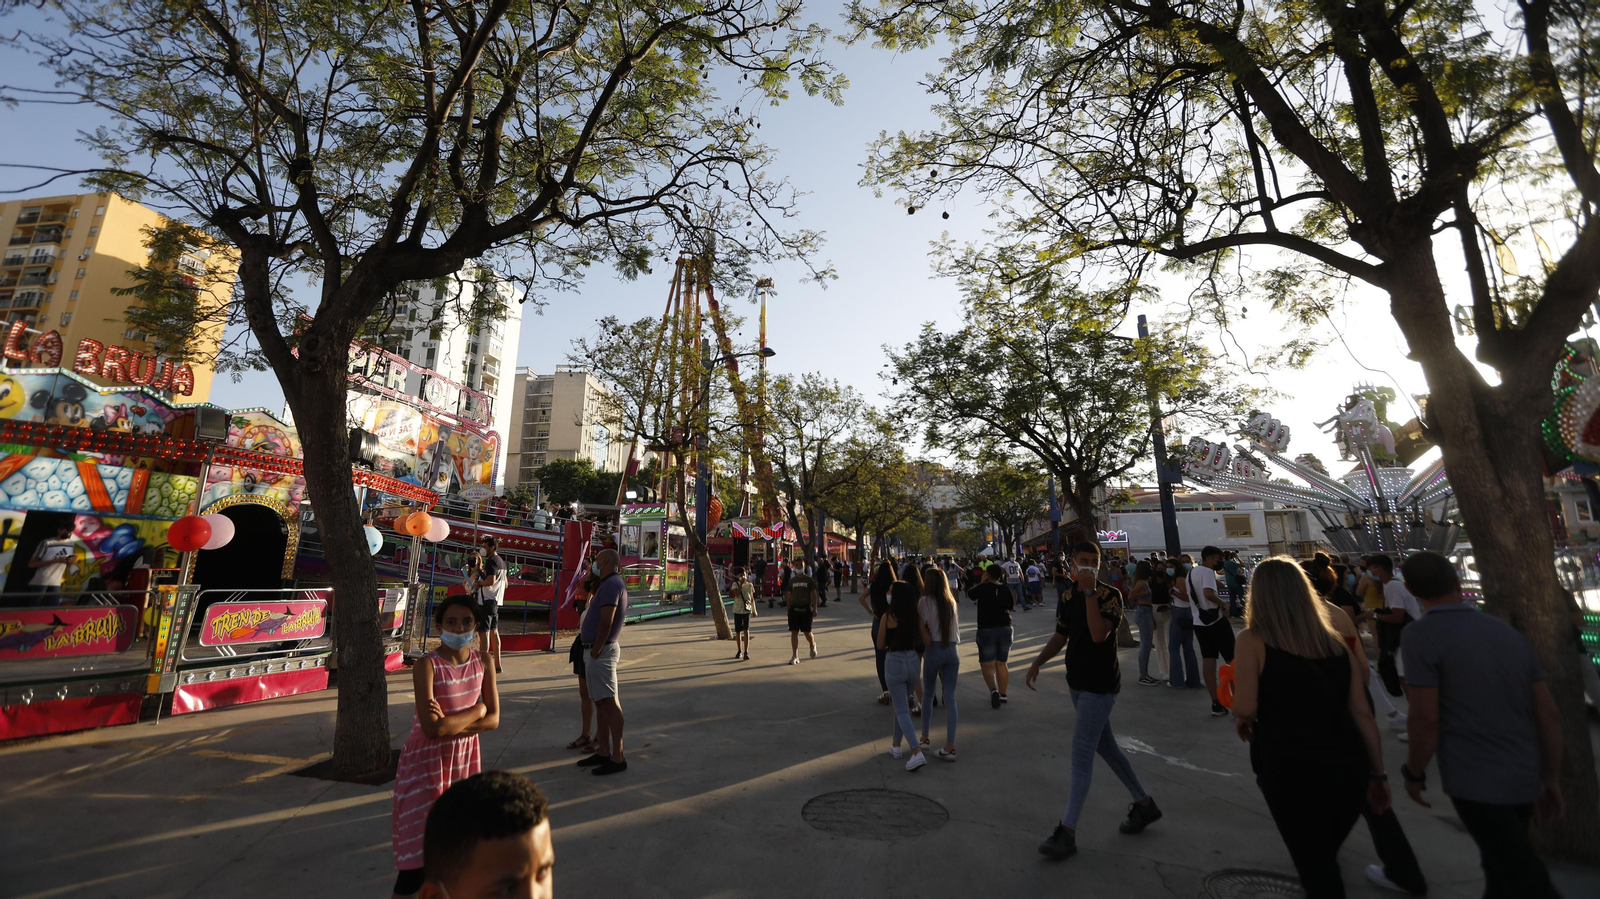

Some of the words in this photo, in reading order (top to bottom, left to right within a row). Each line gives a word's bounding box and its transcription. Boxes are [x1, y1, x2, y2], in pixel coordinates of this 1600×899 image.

[4, 320, 63, 367] LA
[73, 337, 194, 396] BRUJA
[211, 609, 250, 640] TREN
[250, 608, 271, 627] DE
[282, 622, 295, 634] LA
[45, 635, 70, 650] LA
